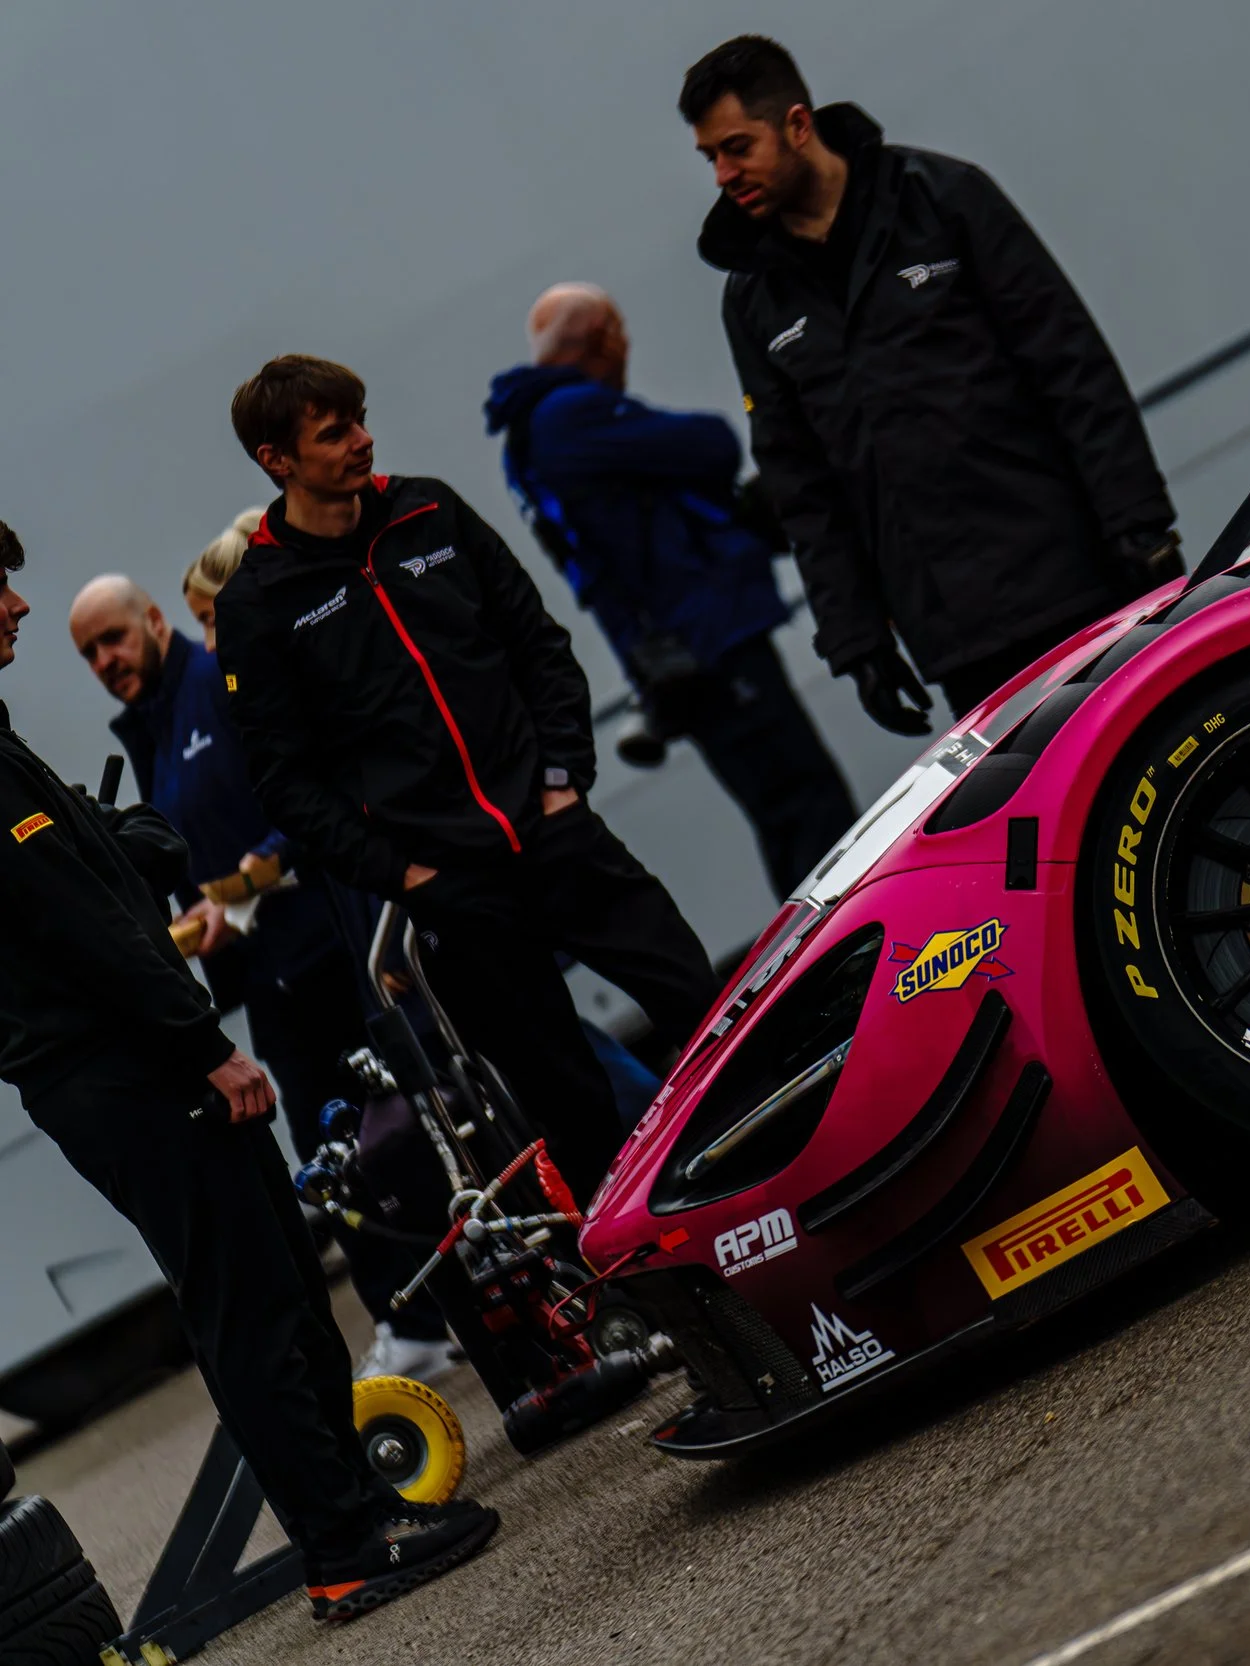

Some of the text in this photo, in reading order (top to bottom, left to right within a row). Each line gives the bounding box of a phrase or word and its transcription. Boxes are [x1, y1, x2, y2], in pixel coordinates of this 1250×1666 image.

[293, 593, 344, 630] McLaren
[1202, 712, 1226, 734] DHG
[901, 923, 997, 998] SUNOCO
[1125, 964, 1159, 999] P
[714, 1207, 795, 1268] APM
[981, 1168, 1145, 1281] PIRELLI
[815, 1338, 883, 1382] HALSO
